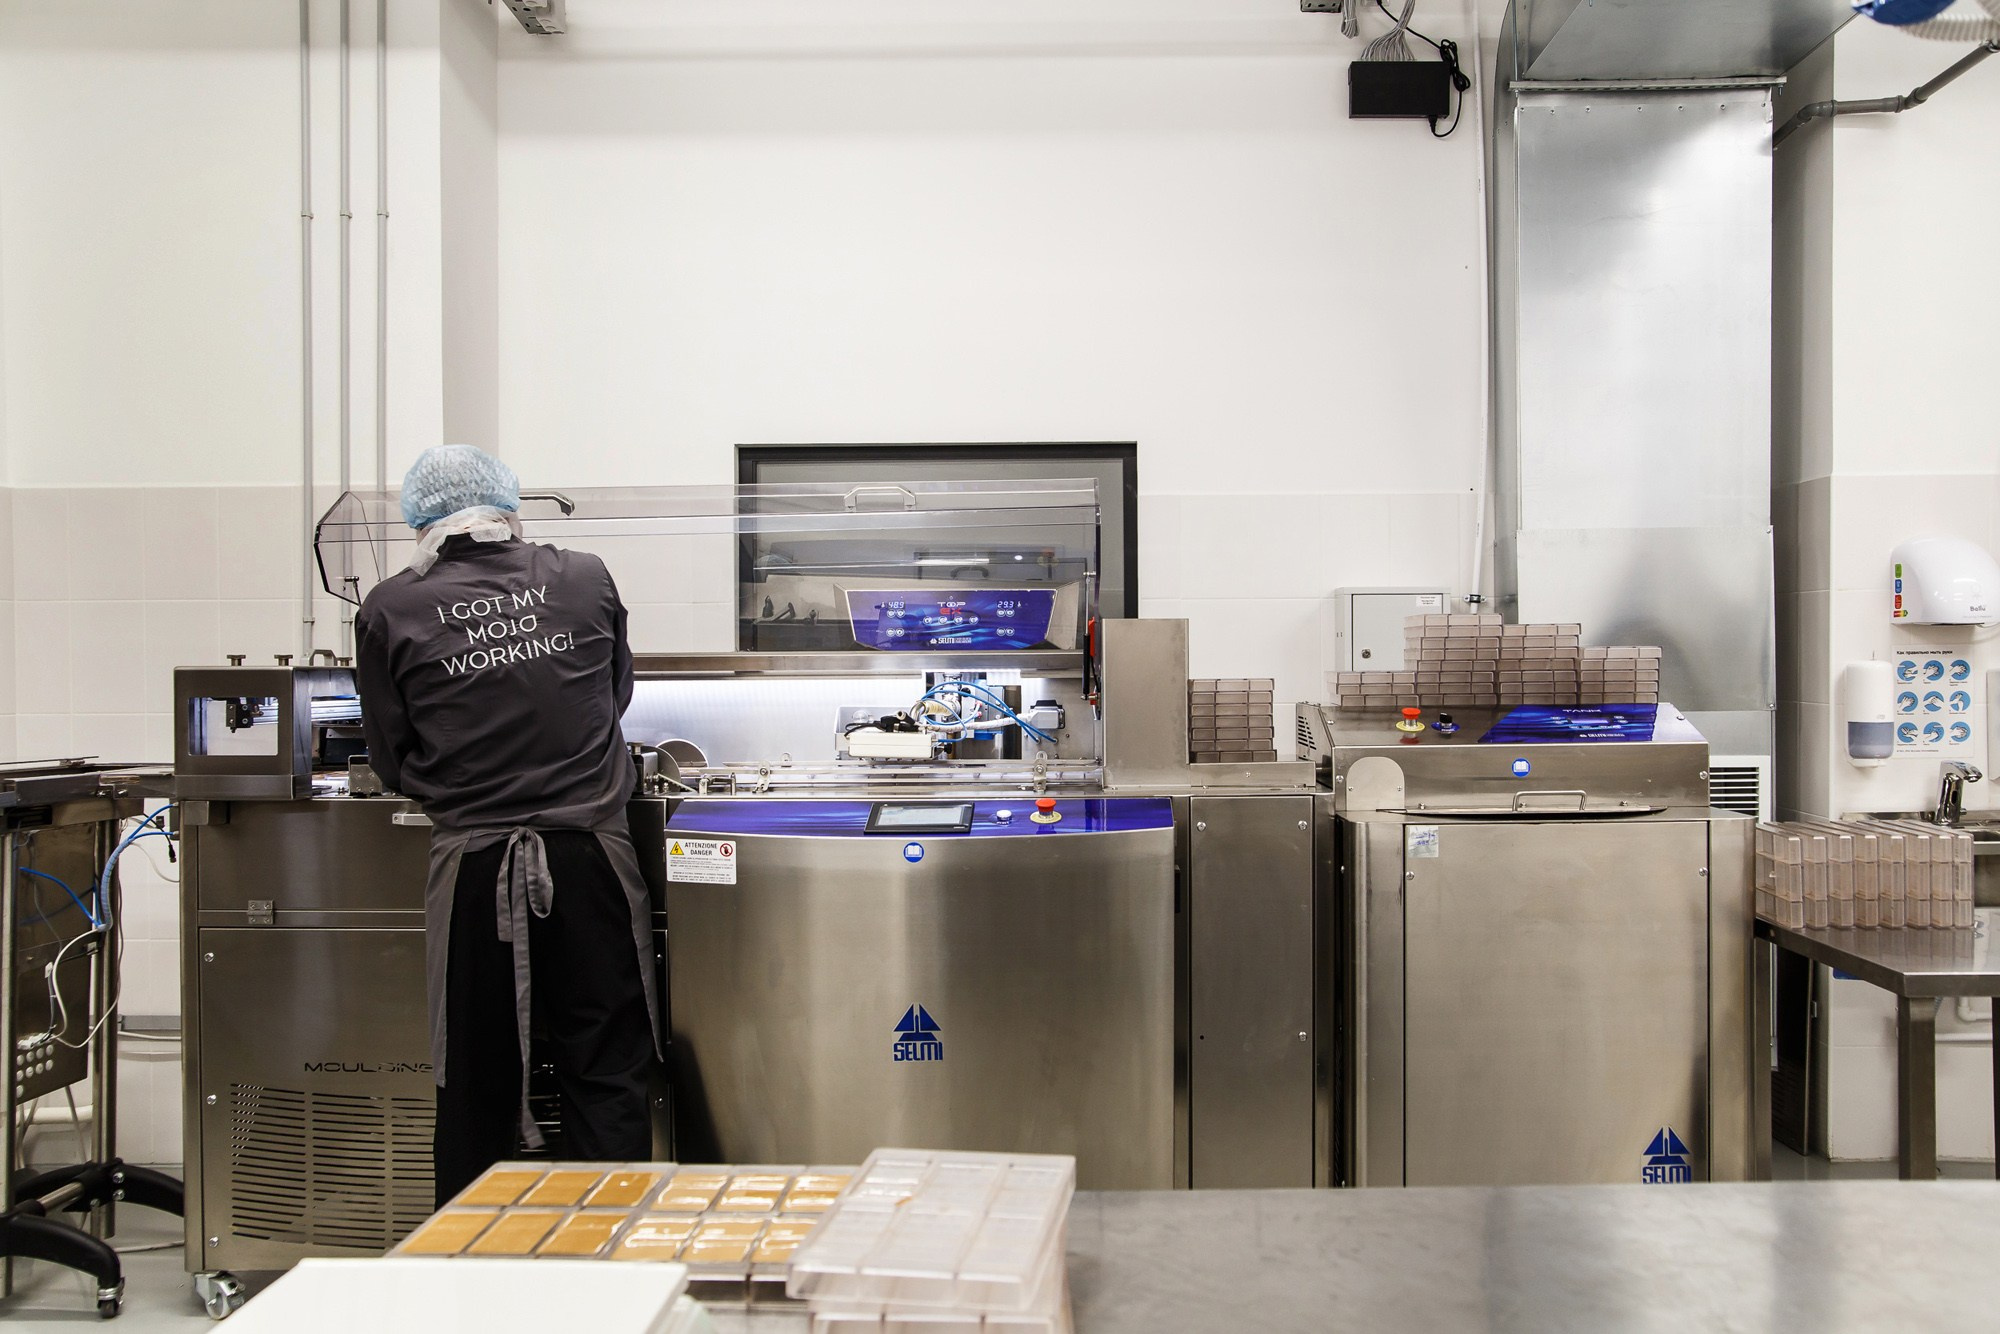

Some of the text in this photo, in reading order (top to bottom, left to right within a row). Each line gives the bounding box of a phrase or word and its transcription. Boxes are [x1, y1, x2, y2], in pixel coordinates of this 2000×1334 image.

[436, 585, 547, 624] I GOT MY
[465, 614, 538, 645] MOJO
[440, 631, 576, 676] WORKING!
[893, 1041, 944, 1062] SELMI
[1642, 1165, 1692, 1184] SELMI
